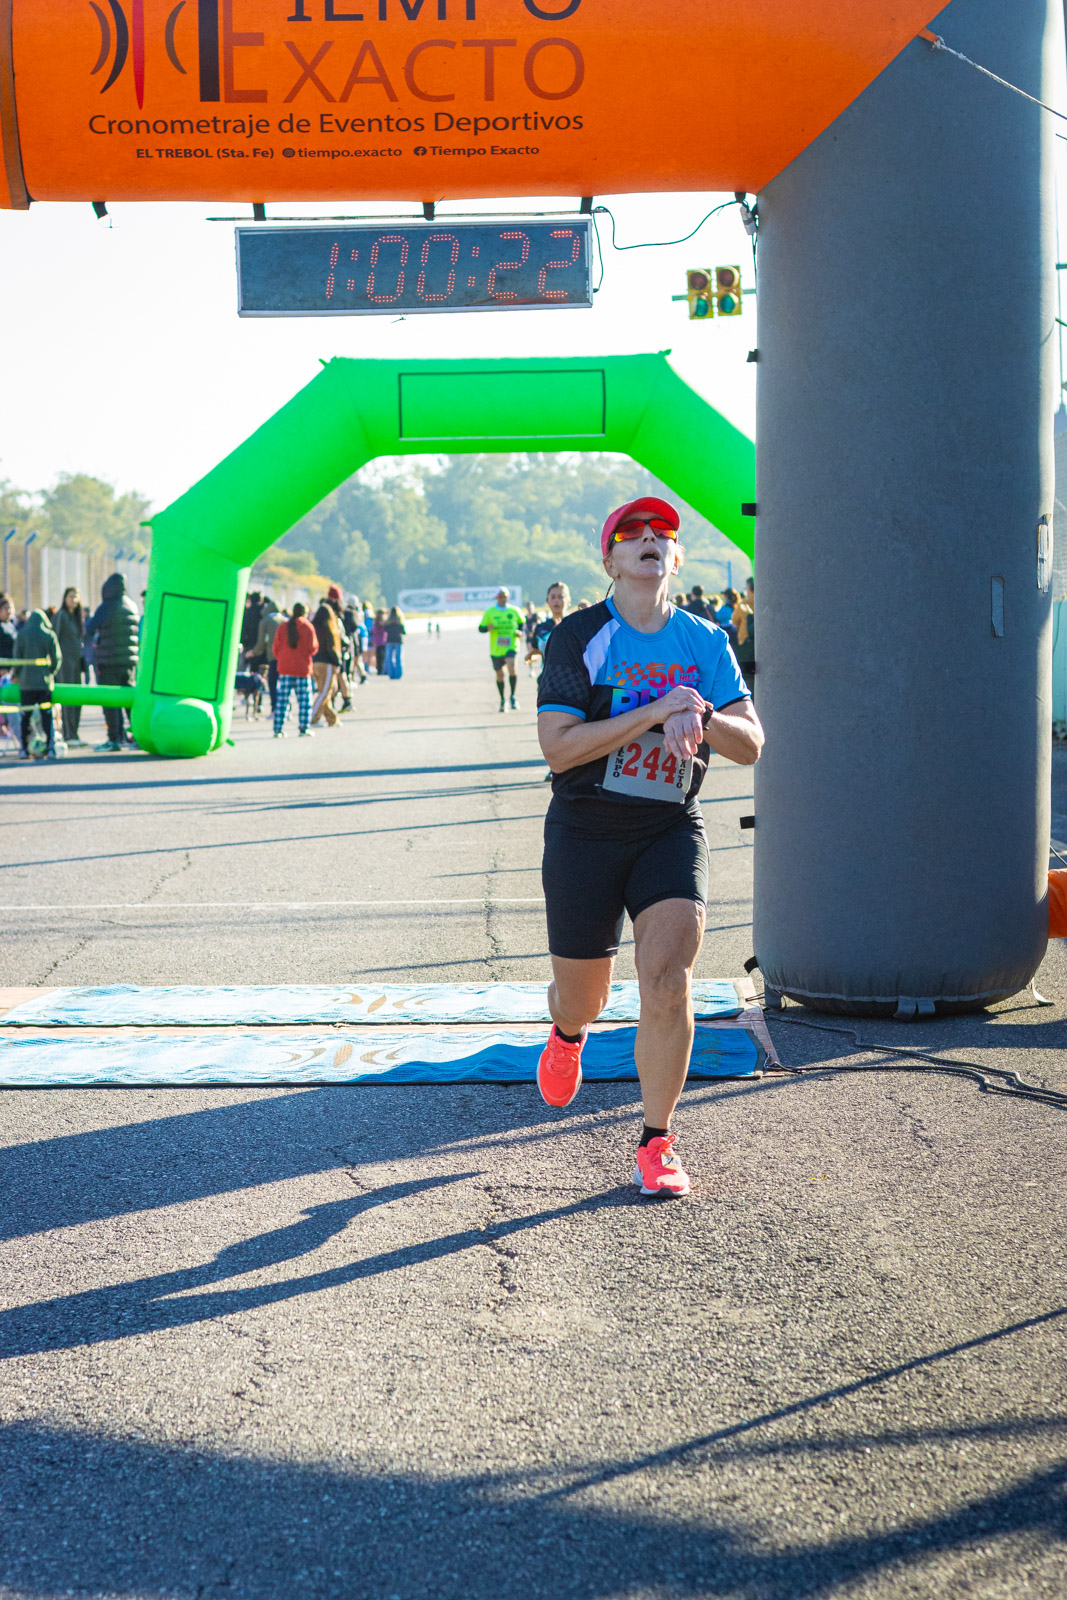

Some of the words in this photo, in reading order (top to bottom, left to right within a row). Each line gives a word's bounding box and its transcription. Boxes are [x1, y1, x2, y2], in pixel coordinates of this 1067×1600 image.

[222, 0, 585, 103] EXACTO
[88, 114, 270, 138] Cronometraje
[277, 113, 311, 133] de
[319, 113, 425, 133] Eventos
[434, 111, 583, 136] Deportivos
[136, 149, 153, 158] EL
[155, 148, 213, 158] TREBOL
[216, 147, 249, 159] (Sta.
[252, 147, 274, 159] Fe)
[297, 147, 403, 159] tiempo.exacto
[429, 146, 487, 157] Tiempo
[490, 145, 540, 155] Exacto
[325, 230, 581, 303] 1:00:22
[613, 746, 624, 778] EMPO
[621, 742, 678, 785] 244
[676, 759, 686, 789] ACTO
